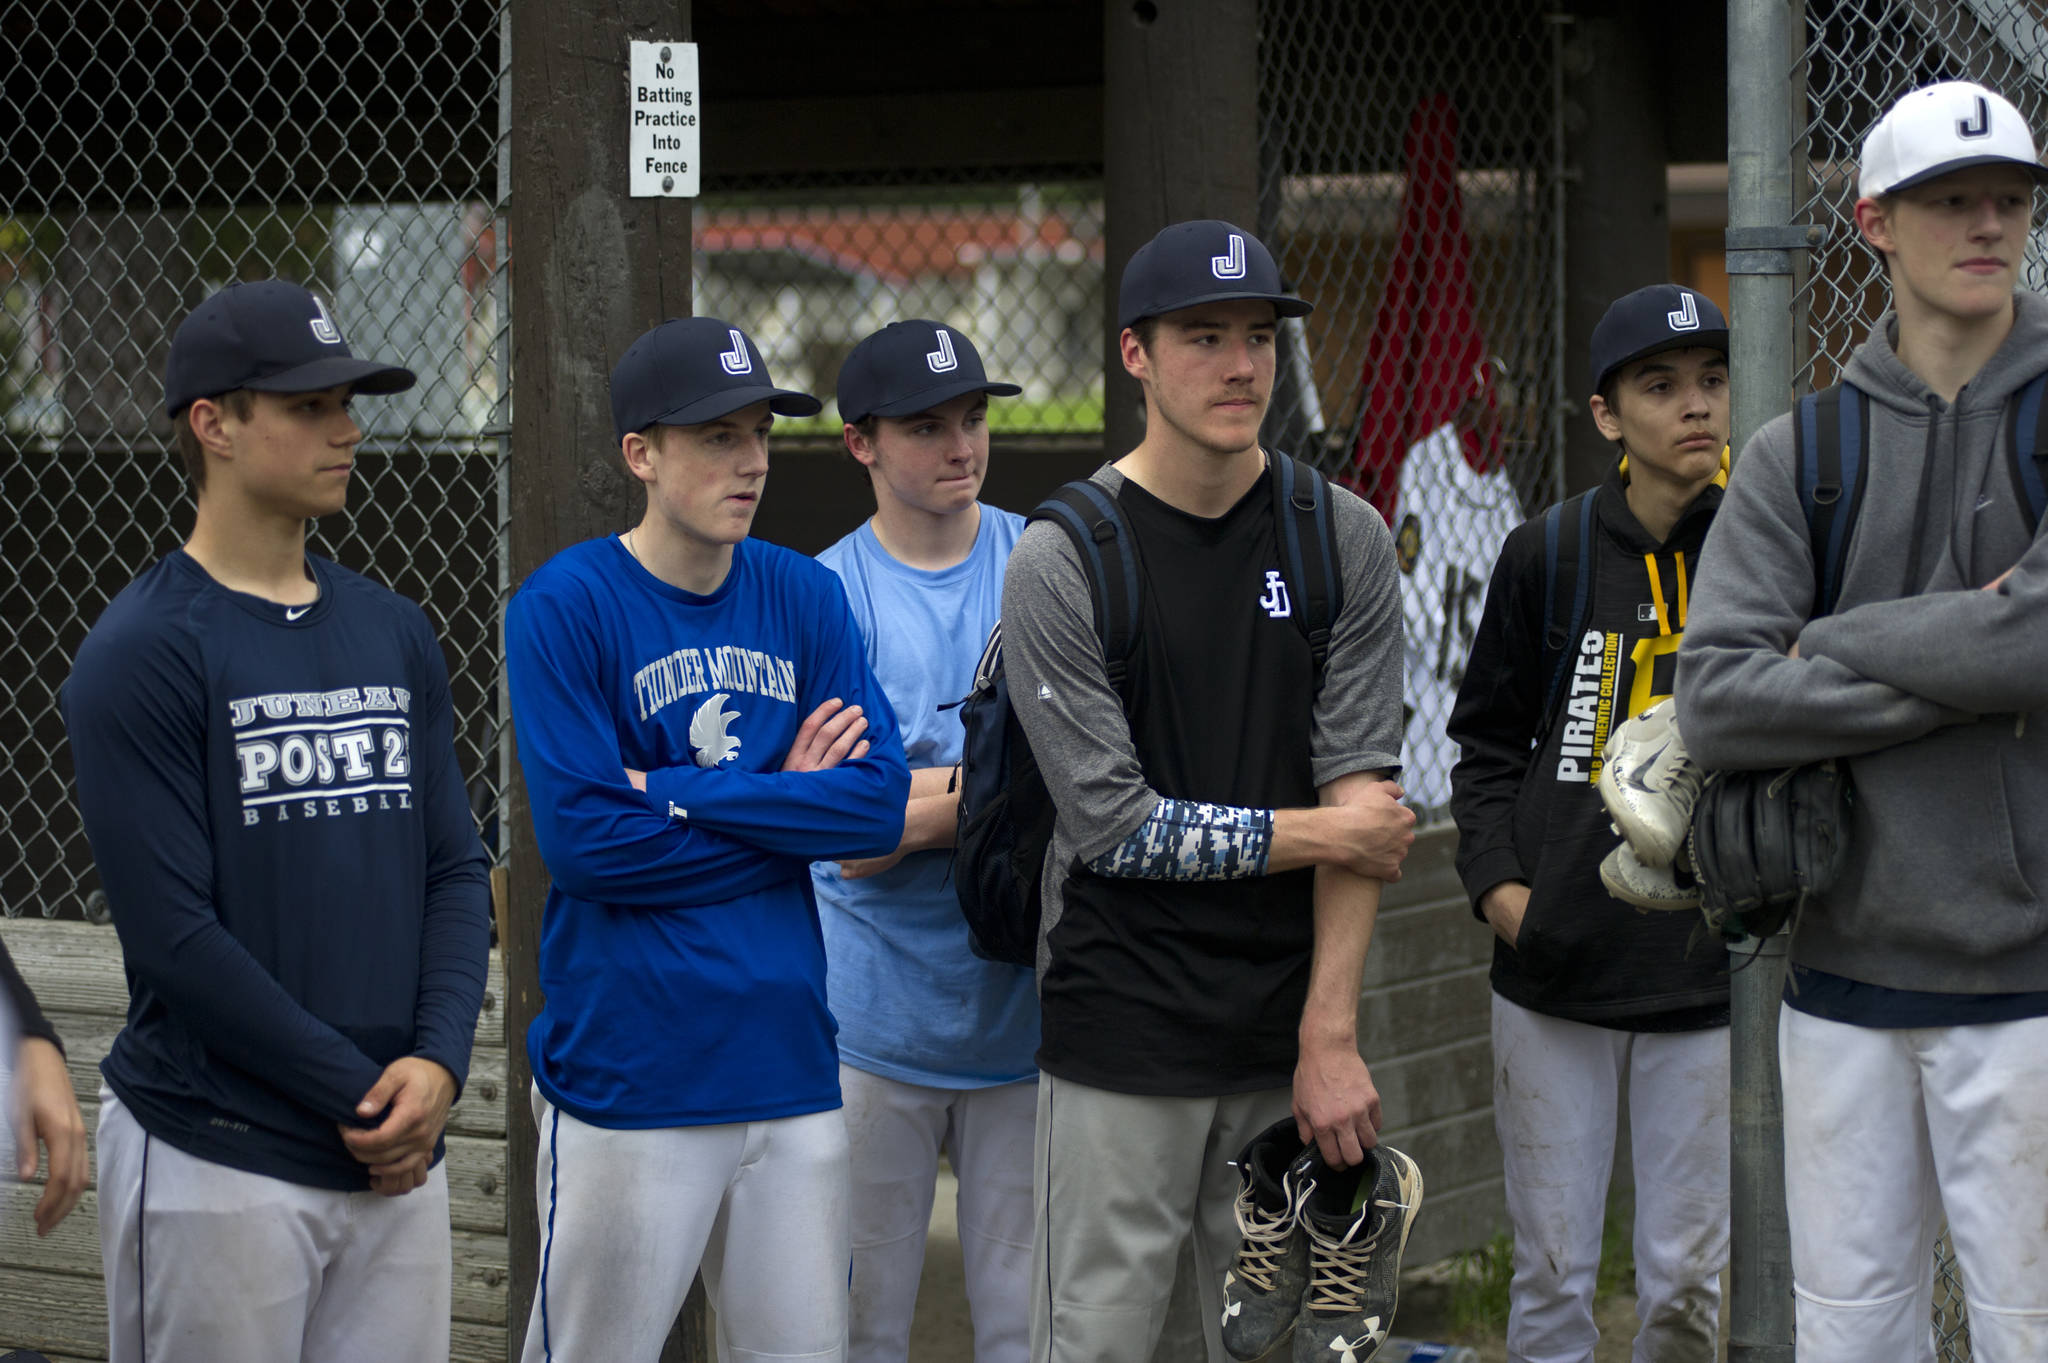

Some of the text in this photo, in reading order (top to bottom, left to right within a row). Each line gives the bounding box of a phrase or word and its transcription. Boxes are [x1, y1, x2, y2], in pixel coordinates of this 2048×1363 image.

[656, 63, 674, 79] No
[634, 110, 696, 127] Practice
[637, 87, 692, 106] Batting
[1955, 95, 1992, 141] J
[652, 134, 681, 150] Into
[645, 157, 688, 174] Fence
[1212, 234, 1246, 279] J
[310, 295, 341, 344] J
[1668, 292, 1700, 331] J
[720, 329, 752, 375] J
[926, 329, 958, 373] J
[1601, 632, 1619, 697] COLLECTION
[1557, 629, 1605, 782] PIRATES
[1593, 699, 1612, 757] AUTHENTIC
[236, 727, 411, 794] POST 2
